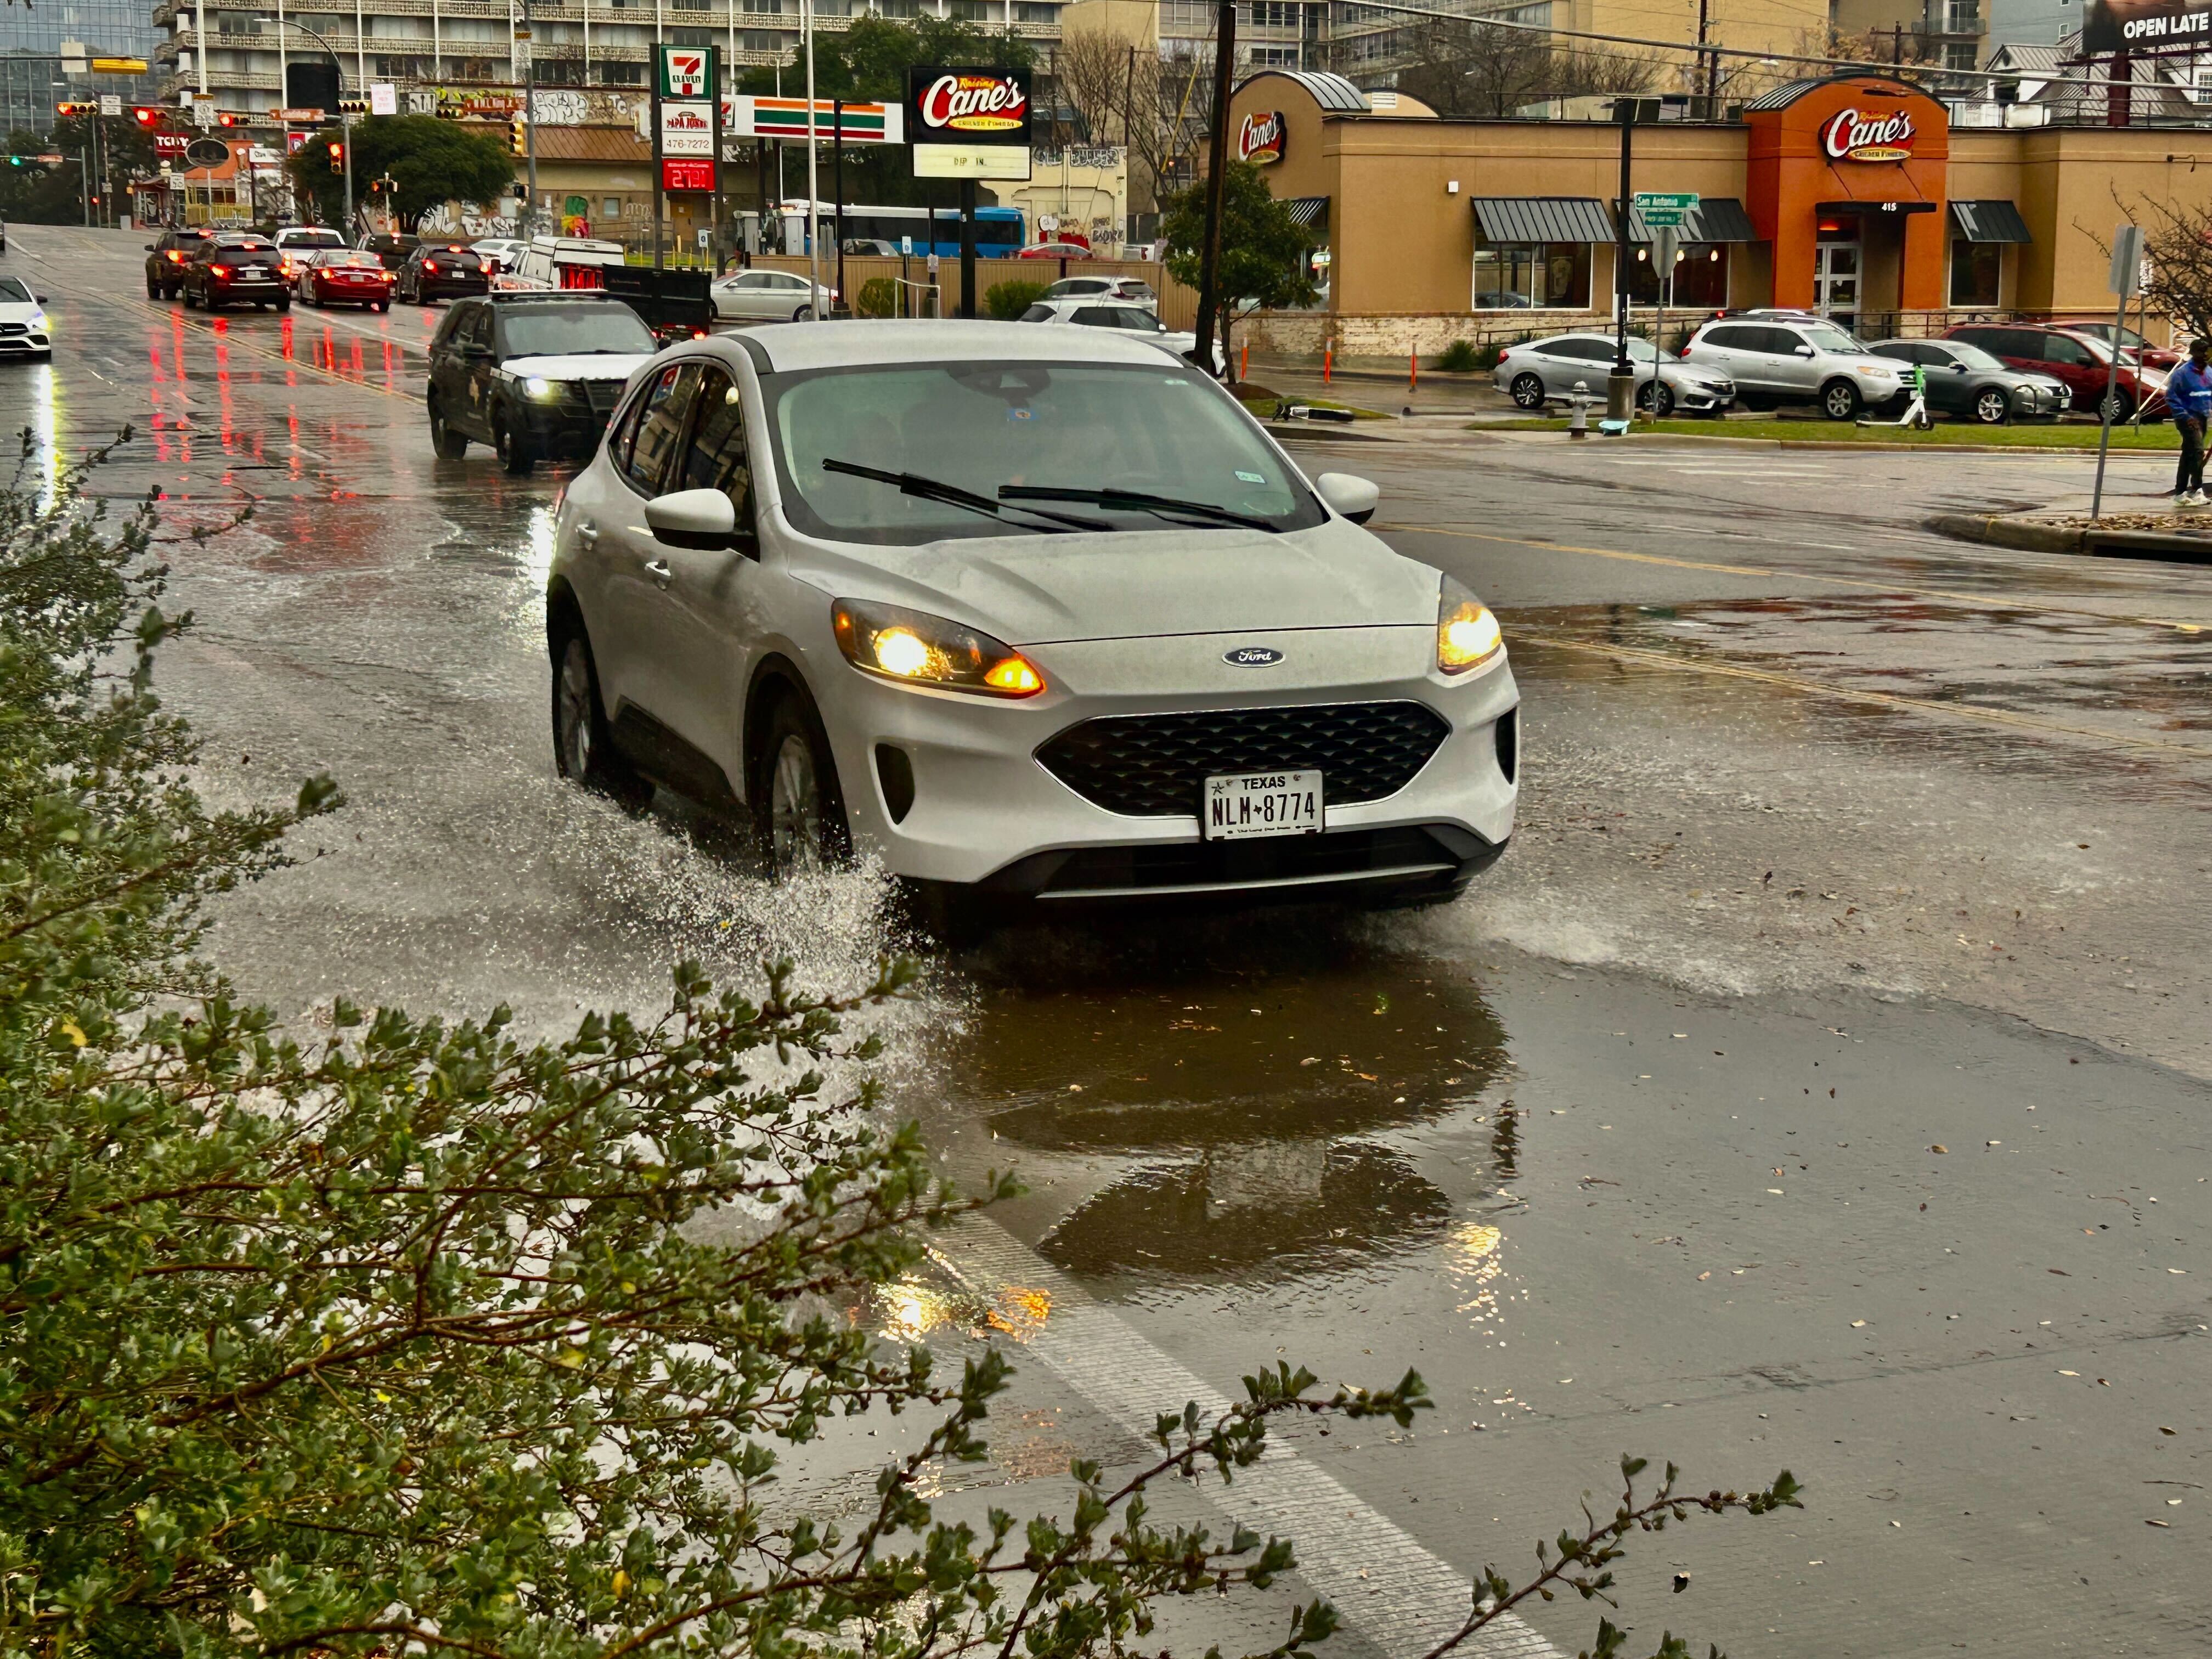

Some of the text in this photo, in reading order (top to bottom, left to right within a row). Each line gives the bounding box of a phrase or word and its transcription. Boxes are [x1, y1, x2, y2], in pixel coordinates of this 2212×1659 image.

[2123, 12, 2209, 39] OPEN LATE
[673, 57, 701, 95] 7
[923, 75, 1025, 127] Cane's
[1239, 111, 1280, 162] Cane's
[1827, 109, 1915, 157] Cane's
[667, 140, 709, 149] 476-7272
[1637, 196, 1650, 207] San
[1882, 202, 1897, 211] 415
[1238, 650, 1272, 662] Ford
[1242, 776, 1285, 790] TEXAS
